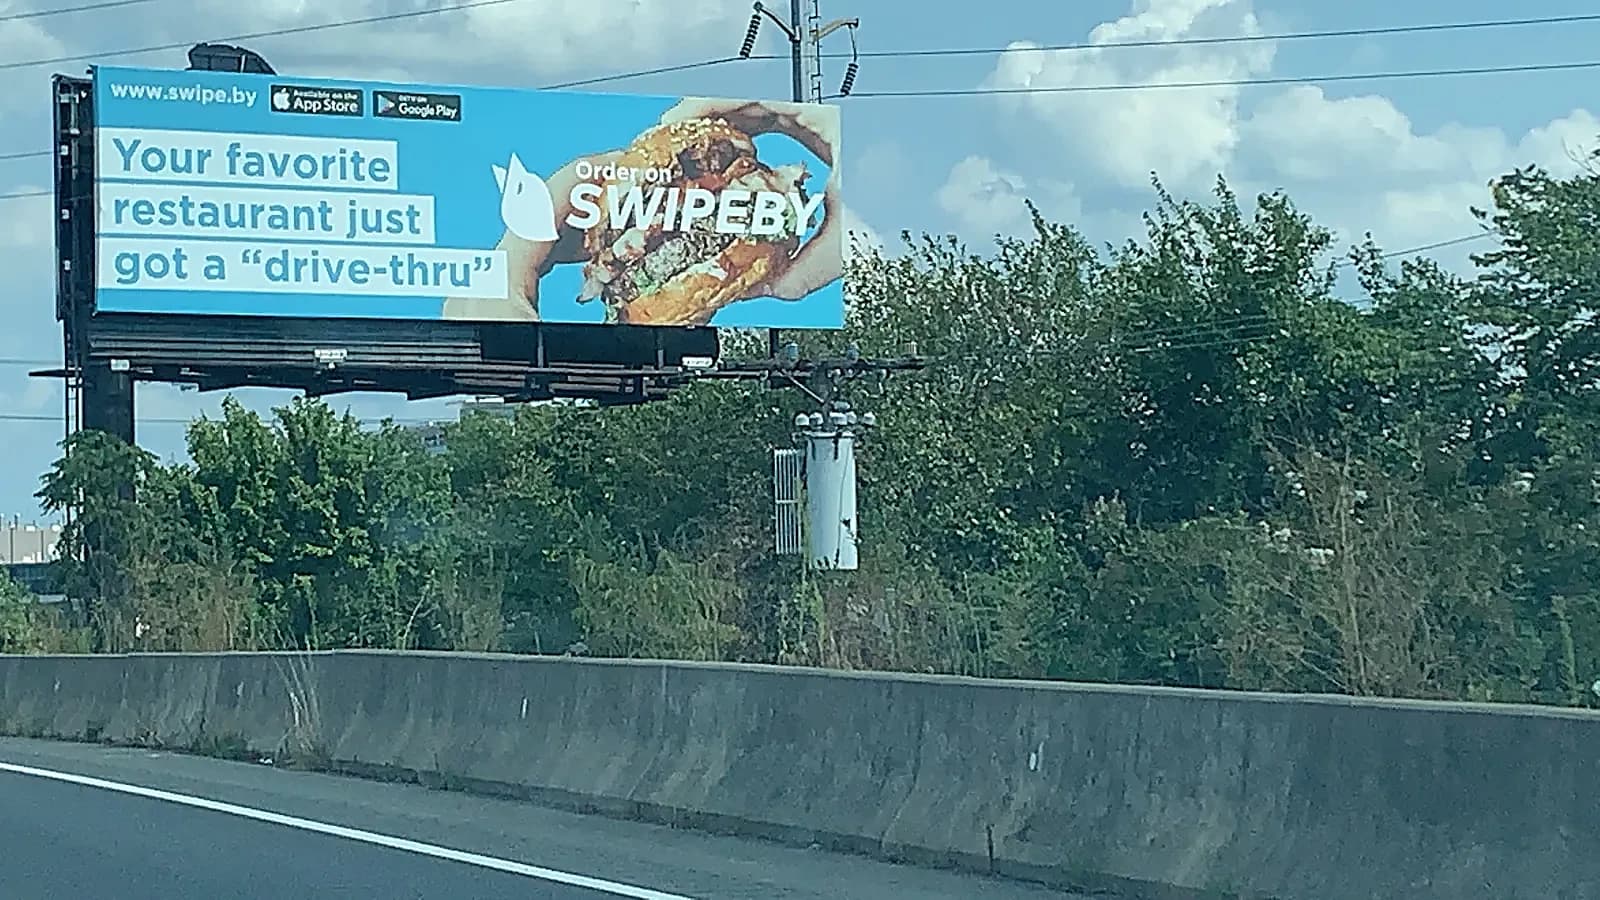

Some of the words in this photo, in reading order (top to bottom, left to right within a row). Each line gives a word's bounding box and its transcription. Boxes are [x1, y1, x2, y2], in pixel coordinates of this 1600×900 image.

[110, 84, 257, 107] www.swipe.by
[293, 97, 322, 113] App
[323, 98, 358, 113] Store
[398, 102, 434, 118] Google
[435, 104, 457, 119] Play
[113, 138, 212, 174] Your
[227, 142, 391, 182] favorite
[575, 160, 636, 181] Order
[645, 164, 672, 182] on
[114, 195, 333, 232] restaurant
[346, 201, 421, 239] just
[565, 184, 825, 236] SWIPEBY
[115, 247, 189, 285] got
[203, 255, 226, 280] a
